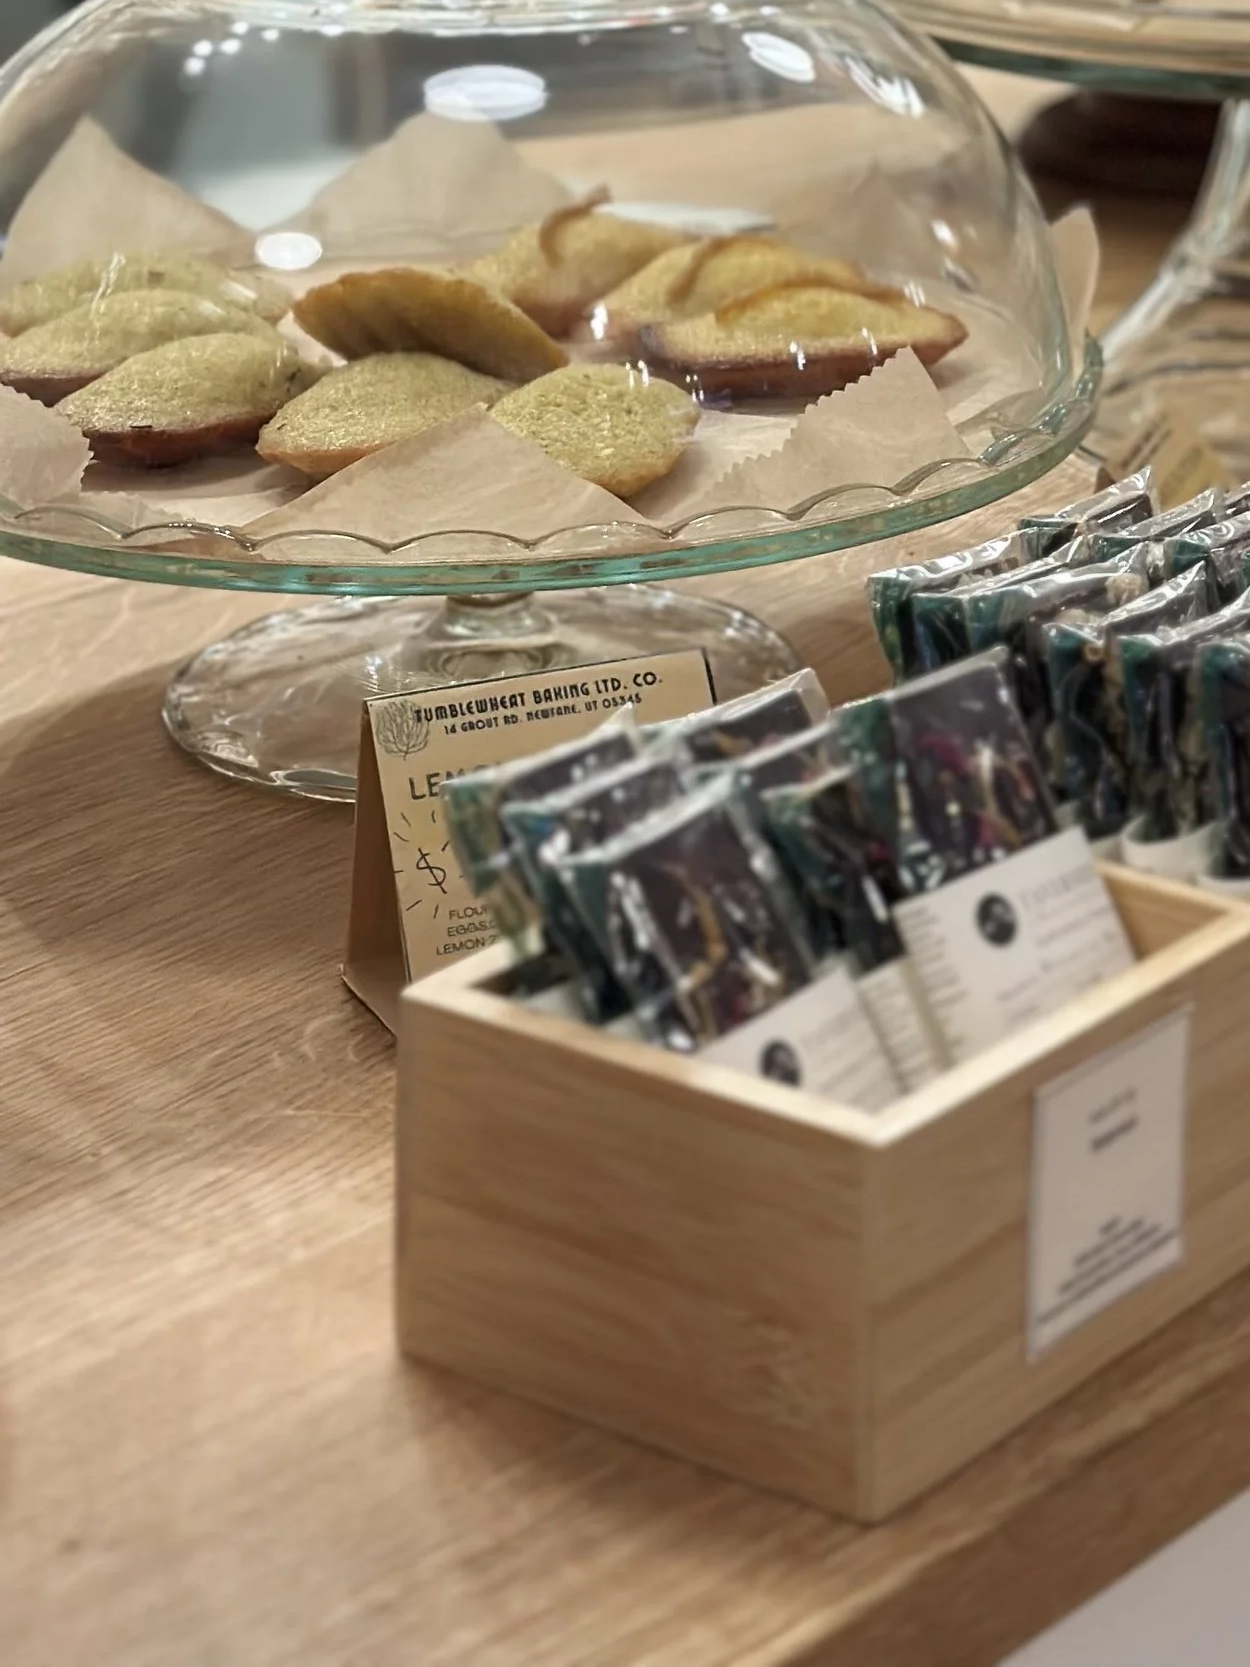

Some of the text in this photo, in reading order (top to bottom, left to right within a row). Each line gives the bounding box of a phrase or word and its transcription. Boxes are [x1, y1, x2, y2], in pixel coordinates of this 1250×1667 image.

[414, 670, 663, 723] TUMBLEWHEAT BAKING LTD. CO.
[460, 717, 500, 733] GROUT
[503, 713, 523, 726] RD.
[435, 936, 486, 957] LEMON
